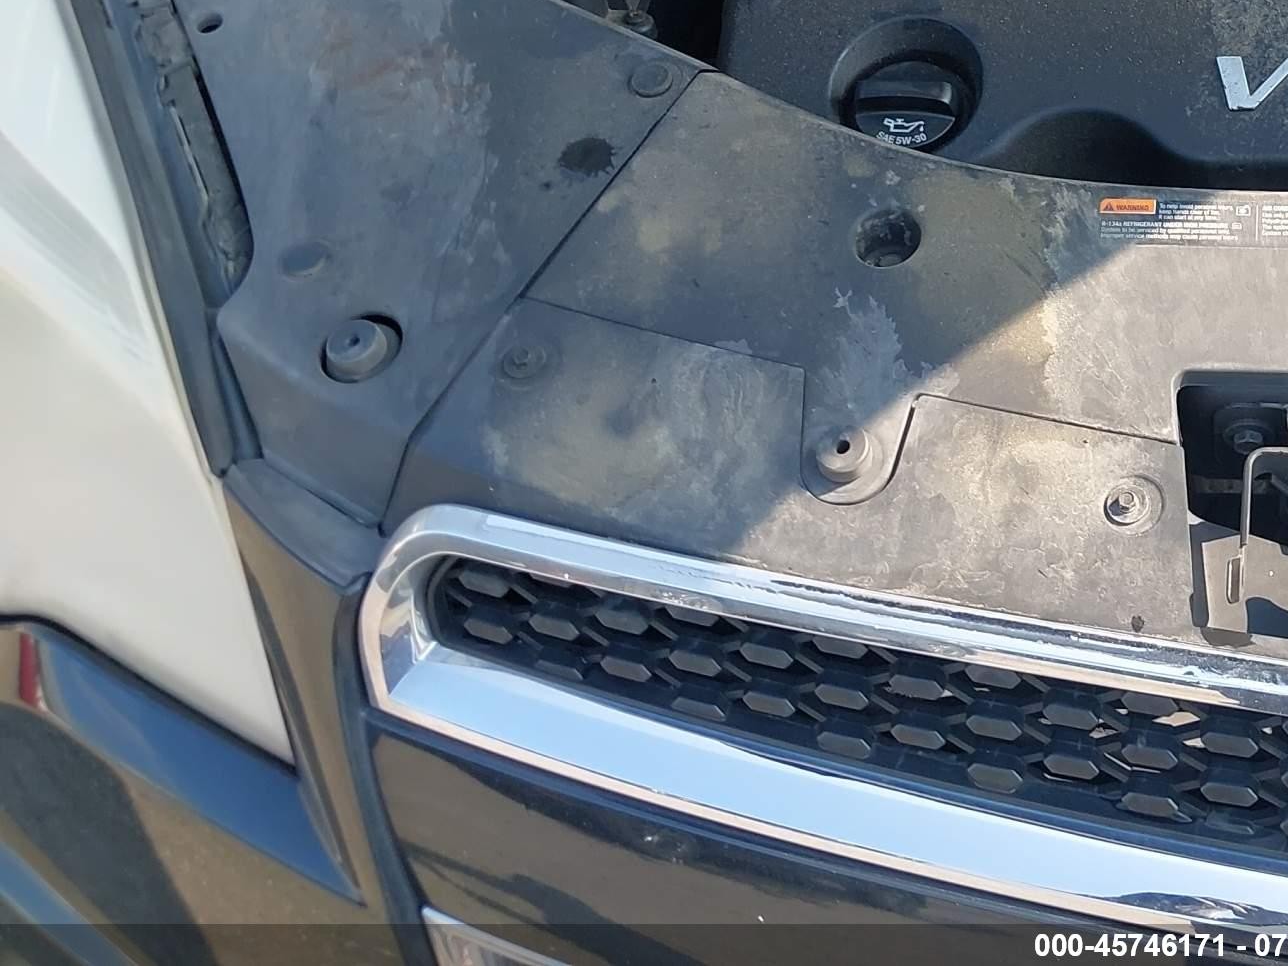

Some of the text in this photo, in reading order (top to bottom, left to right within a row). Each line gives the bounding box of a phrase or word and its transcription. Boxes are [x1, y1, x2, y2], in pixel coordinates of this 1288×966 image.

[876, 131, 928, 146] SAE 5W-30
[1116, 204, 1150, 212] WARNING
